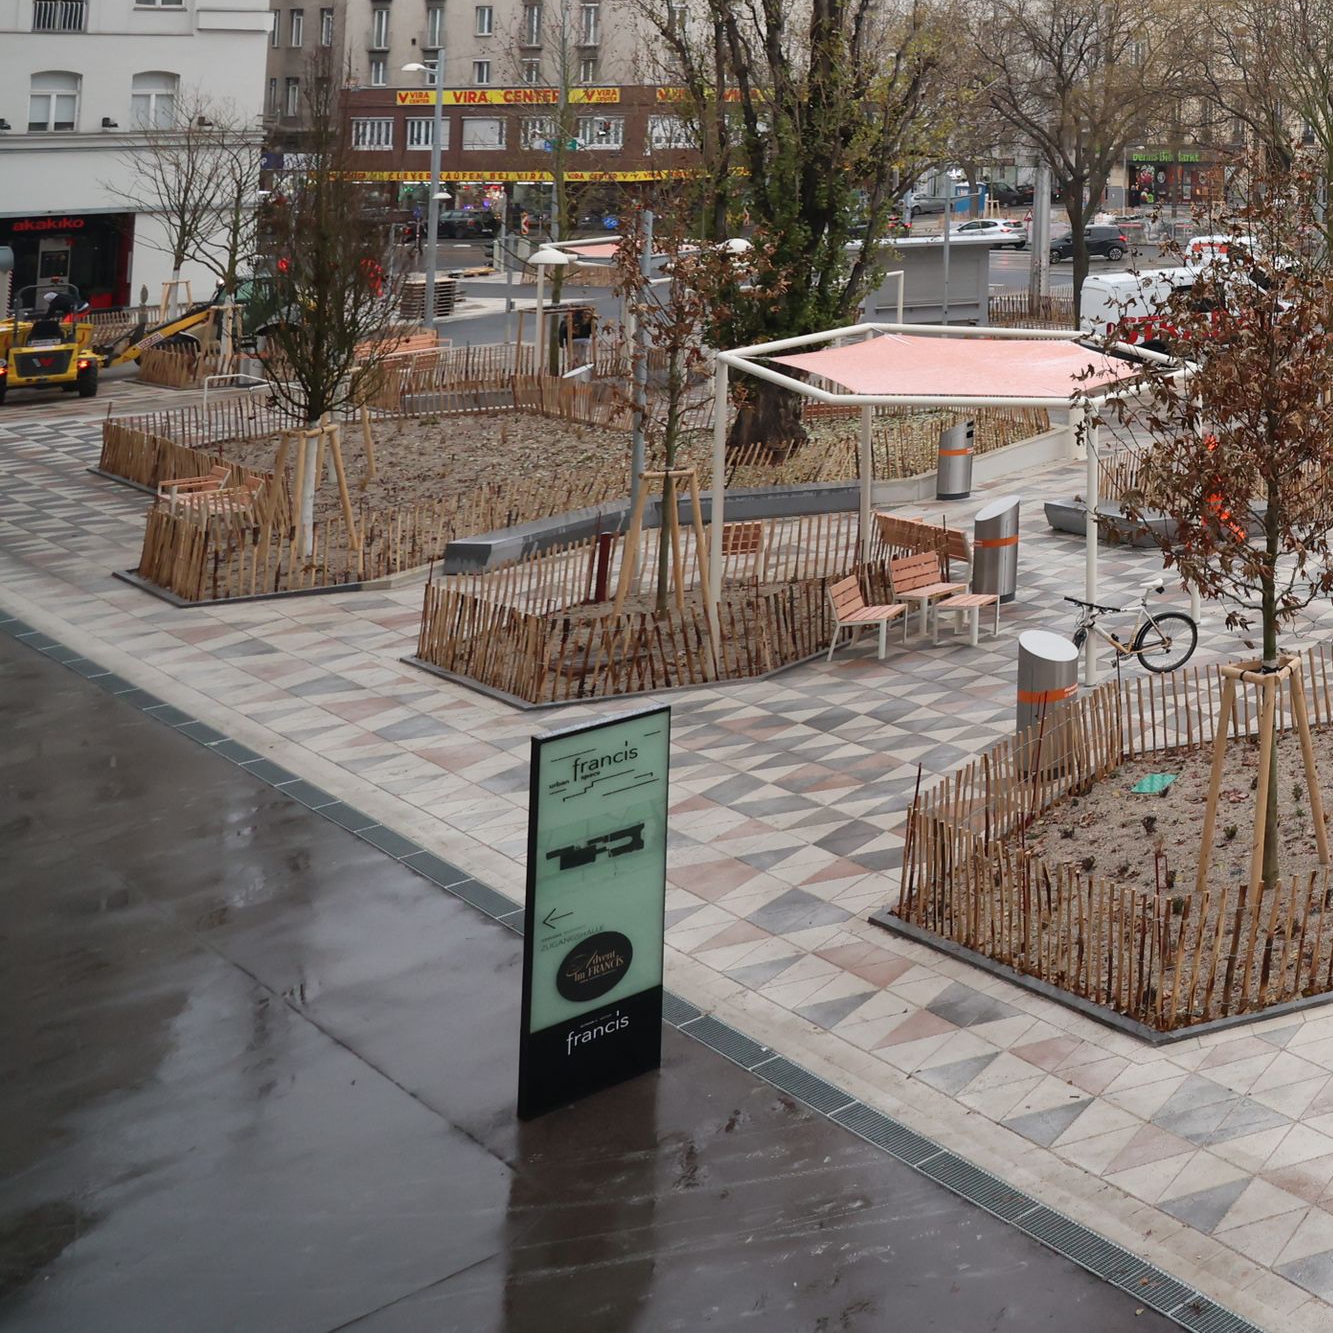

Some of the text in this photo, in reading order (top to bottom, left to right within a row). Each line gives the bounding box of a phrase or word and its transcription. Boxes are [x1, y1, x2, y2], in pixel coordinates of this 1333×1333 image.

[453, 91, 489, 103] VIRA
[388, 172, 546, 180] CLEVER KAUFEN BEI VIRA
[12, 218, 85, 232] akakiko
[572, 740, 638, 782] francis
[548, 771, 601, 789] urban space
[566, 1010, 630, 1055] francis
